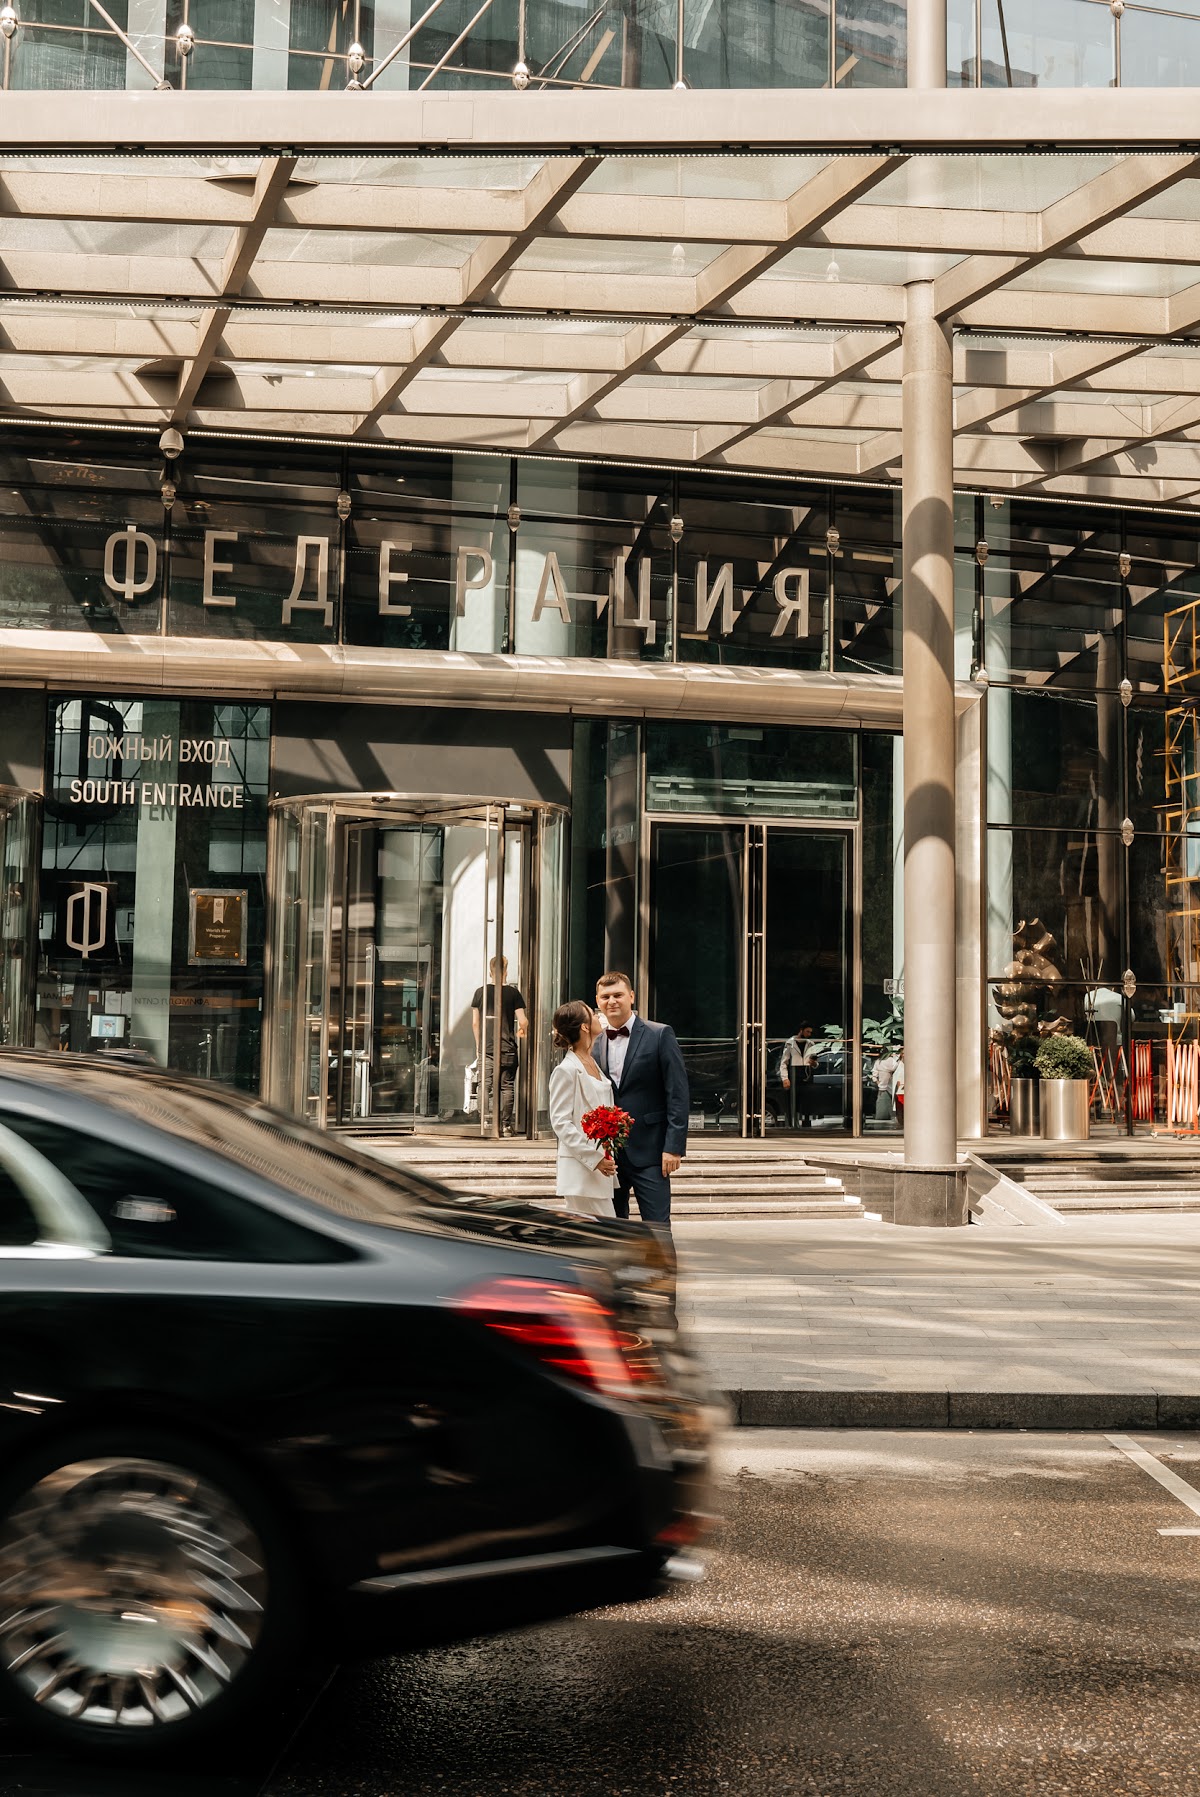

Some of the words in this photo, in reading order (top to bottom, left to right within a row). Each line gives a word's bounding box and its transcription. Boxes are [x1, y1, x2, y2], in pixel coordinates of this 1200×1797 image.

[103, 525, 811, 645] ФЕДЕРАЦИЯ
[87, 734, 172, 761] ЮЖНЫЙ
[179, 738, 231, 768] ВХОД
[69, 779, 135, 805] SOUTH
[141, 782, 244, 808] ENTRANCE
